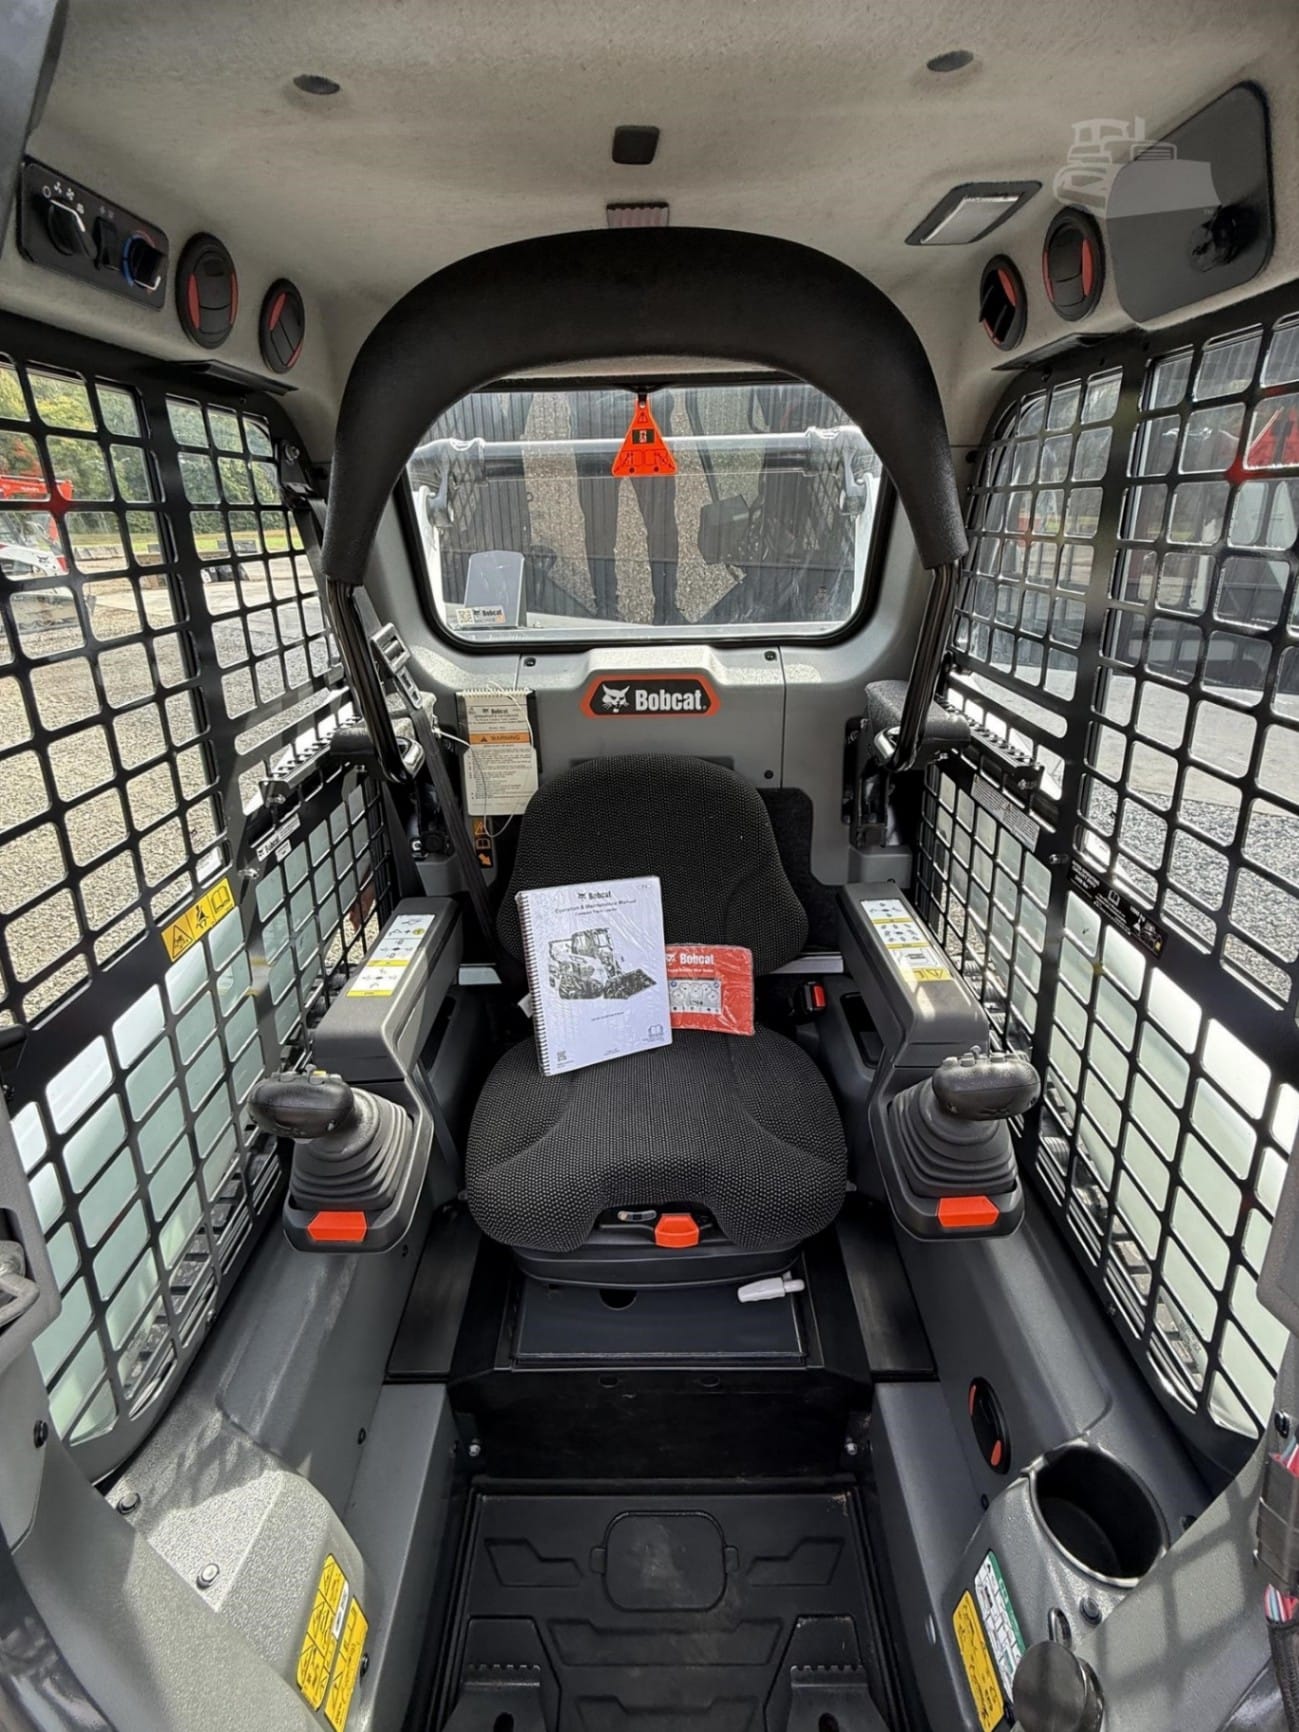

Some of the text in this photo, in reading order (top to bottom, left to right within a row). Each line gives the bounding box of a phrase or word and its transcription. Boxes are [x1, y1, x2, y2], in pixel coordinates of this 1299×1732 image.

[635, 689, 702, 711] Bobcat
[588, 890, 611, 900] Bobcat
[680, 953, 714, 965] Bobcat
